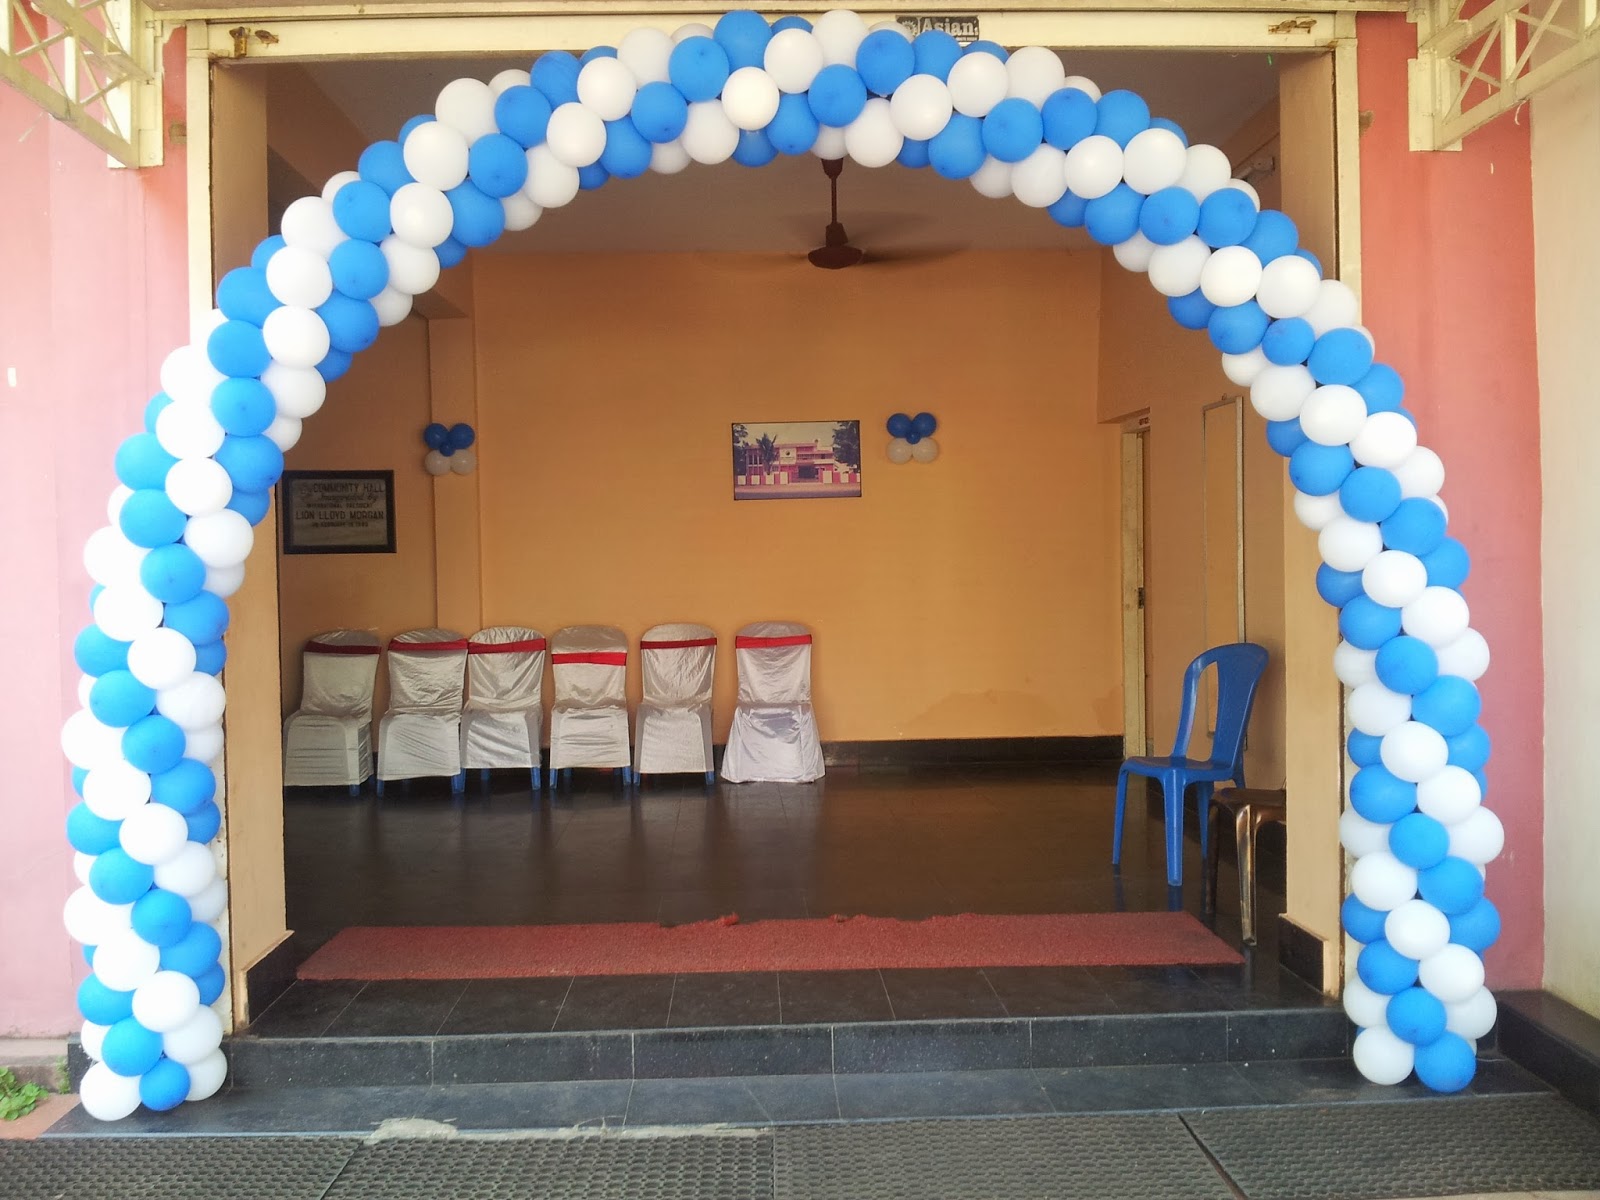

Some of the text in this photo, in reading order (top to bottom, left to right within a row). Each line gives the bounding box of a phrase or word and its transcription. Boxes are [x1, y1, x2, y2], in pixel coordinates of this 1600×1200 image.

[921, 18, 975, 36] Asian
[313, 482, 359, 493] COMMUNITY
[363, 483, 384, 493] HALL
[296, 511, 384, 520] LION LLOYD MORGAN
